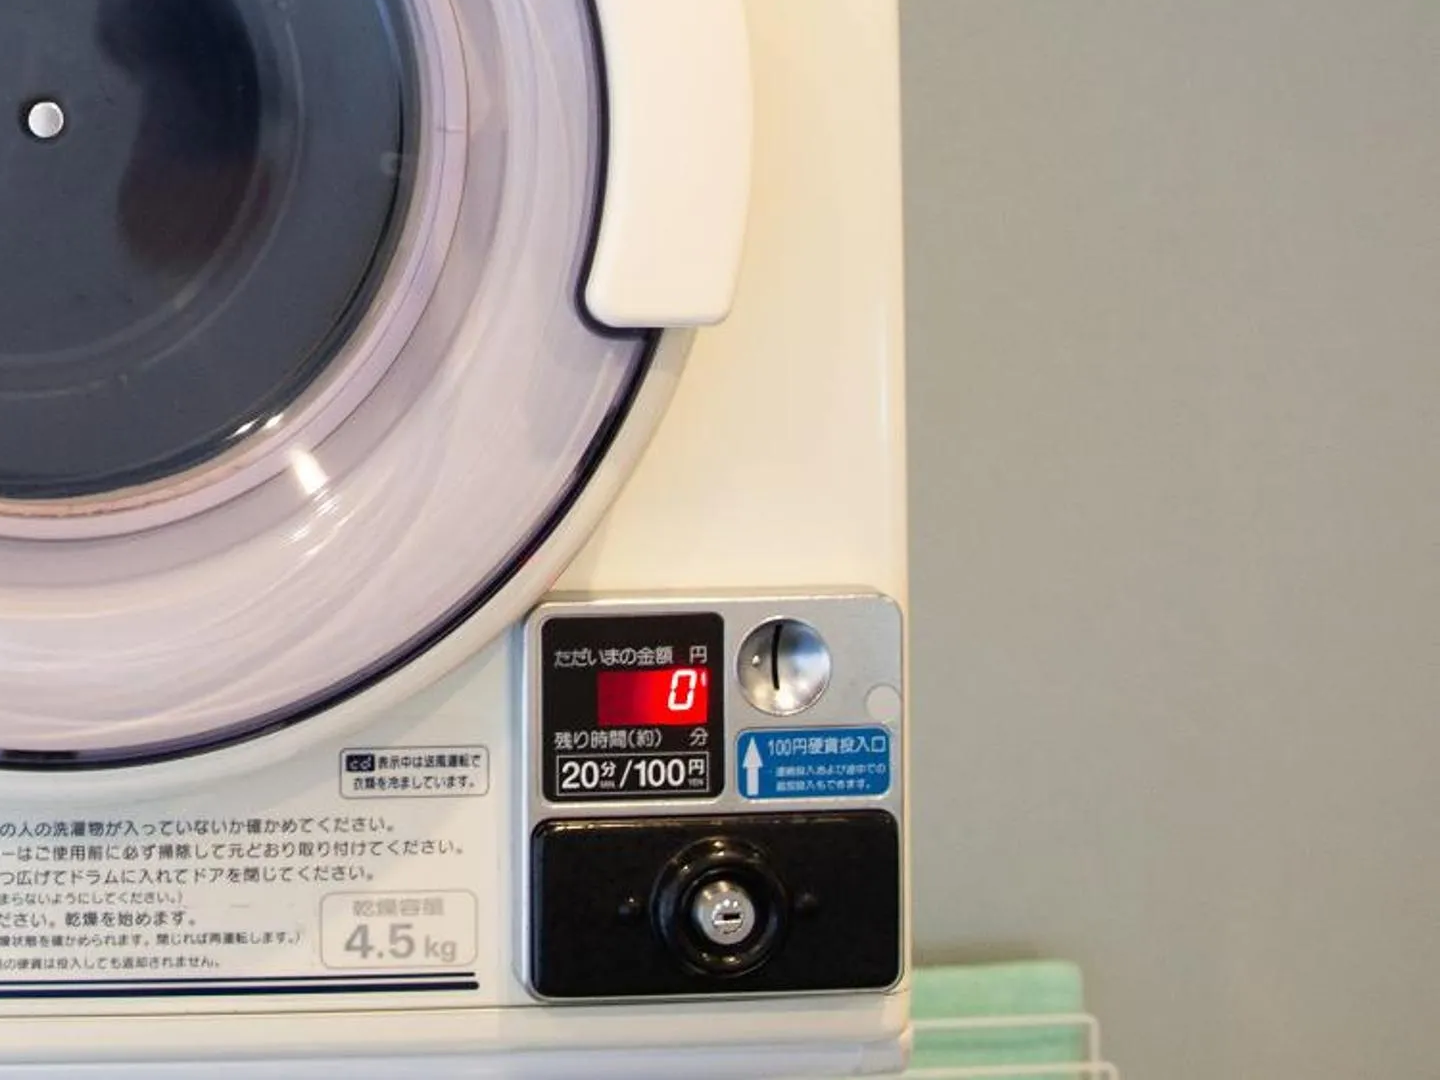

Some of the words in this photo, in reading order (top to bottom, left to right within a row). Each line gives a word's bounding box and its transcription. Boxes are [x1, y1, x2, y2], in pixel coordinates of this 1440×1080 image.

[554, 647, 673, 668] ただいまの金額
[689, 645, 708, 664] 円
[554, 731, 662, 750] 残り時間(約)
[689, 728, 709, 747] 分
[767, 735, 886, 756] 100円硬貨投入口
[344, 923, 415, 959] 4.5
[424, 935, 457, 963] kg
